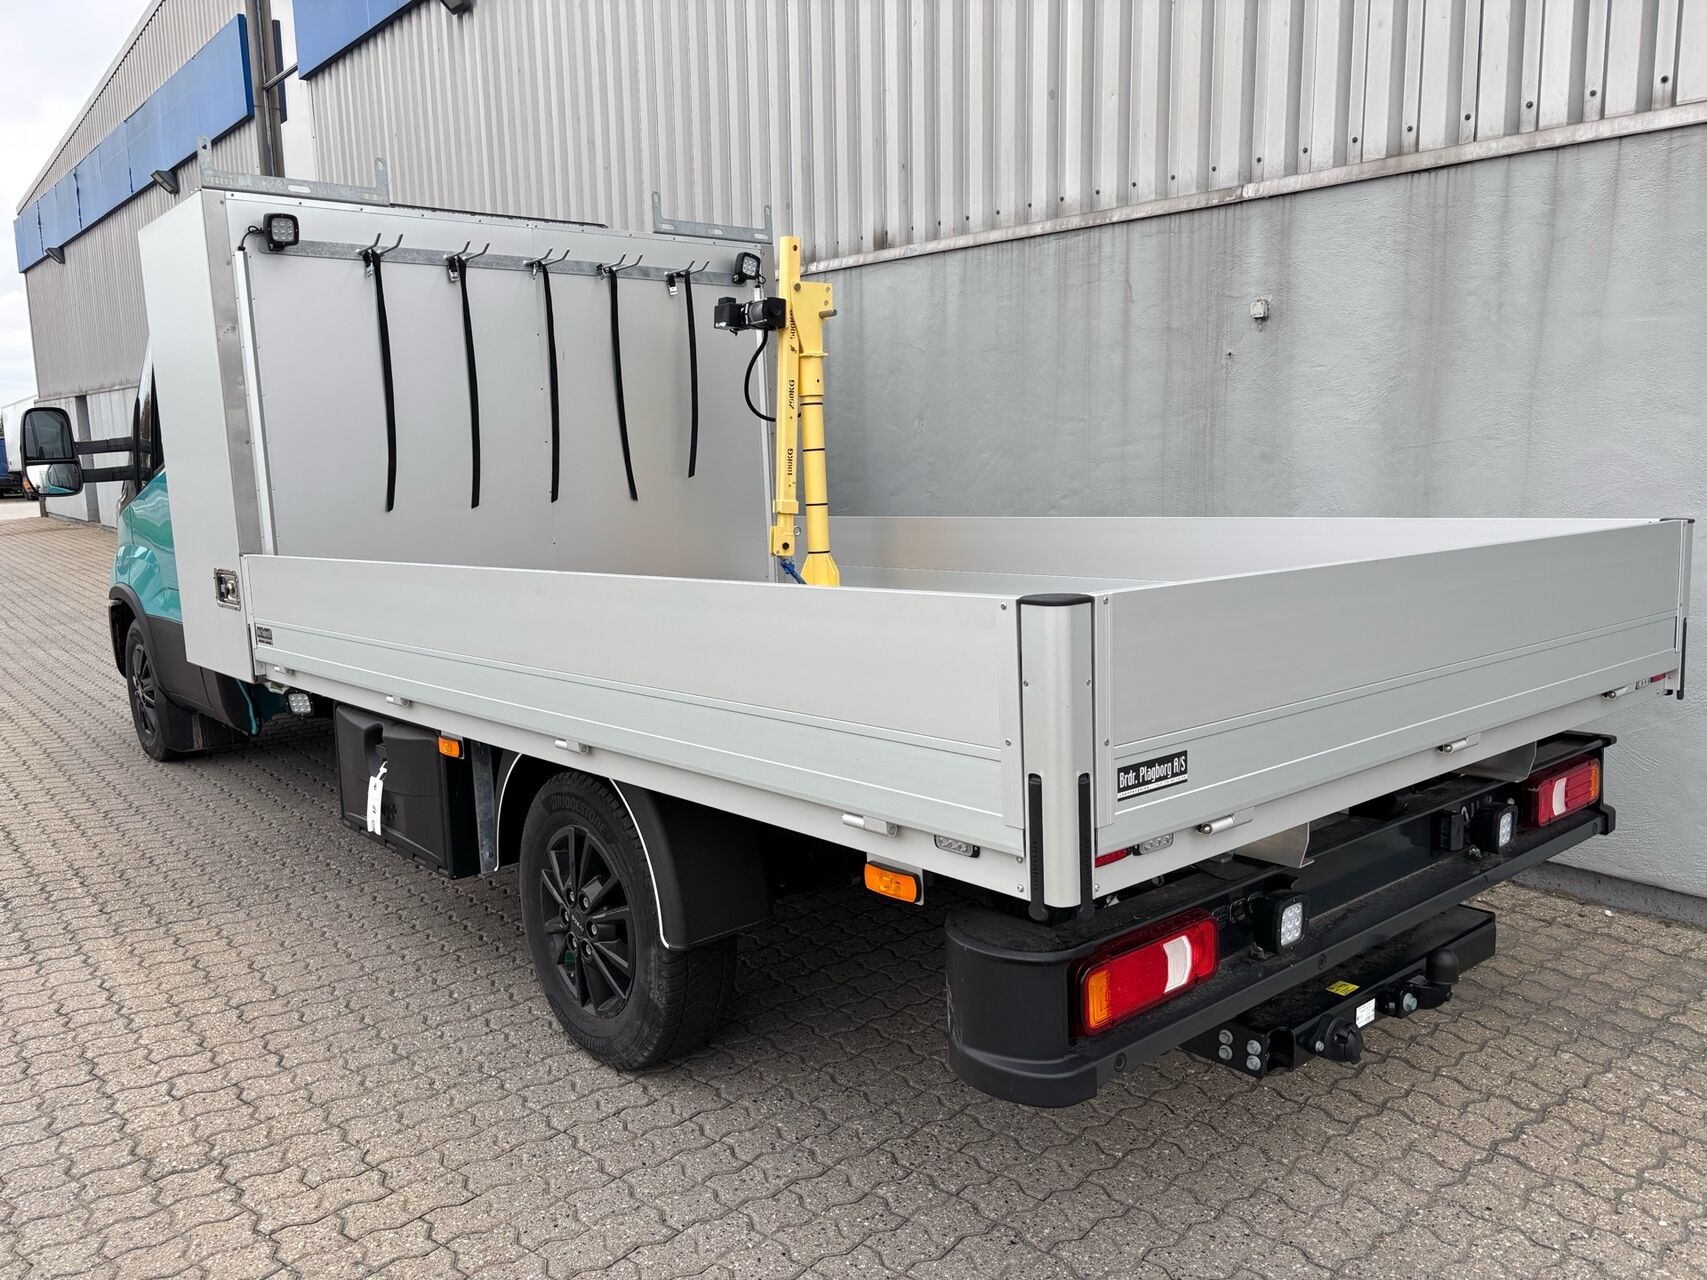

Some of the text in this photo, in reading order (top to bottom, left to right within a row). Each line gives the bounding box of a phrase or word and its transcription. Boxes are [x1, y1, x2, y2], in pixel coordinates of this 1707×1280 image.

[788, 379, 796, 410] 250KG
[1119, 769, 1138, 789] Brdr.
[1139, 762, 1172, 783] Plagborg
[1173, 755, 1186, 773] A/S
[551, 793, 608, 833] BRIDGESTONE
